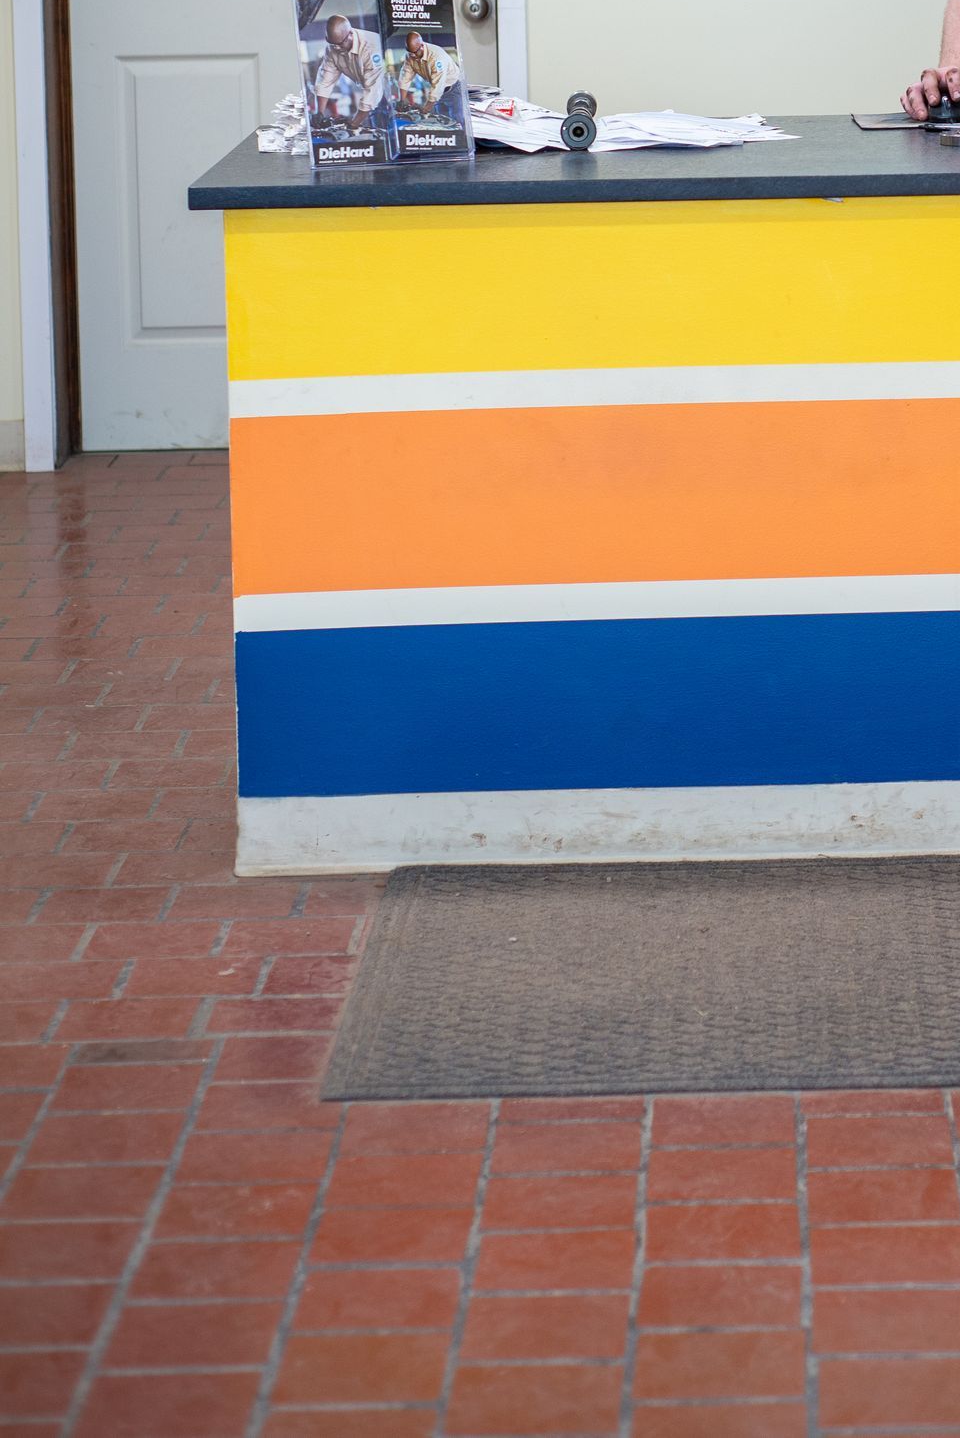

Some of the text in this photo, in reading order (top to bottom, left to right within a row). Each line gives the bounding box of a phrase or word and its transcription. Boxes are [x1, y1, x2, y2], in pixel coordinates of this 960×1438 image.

[392, 11, 418, 19] COUNT
[405, 134, 457, 146] DieHard
[319, 145, 374, 160] DieHard
